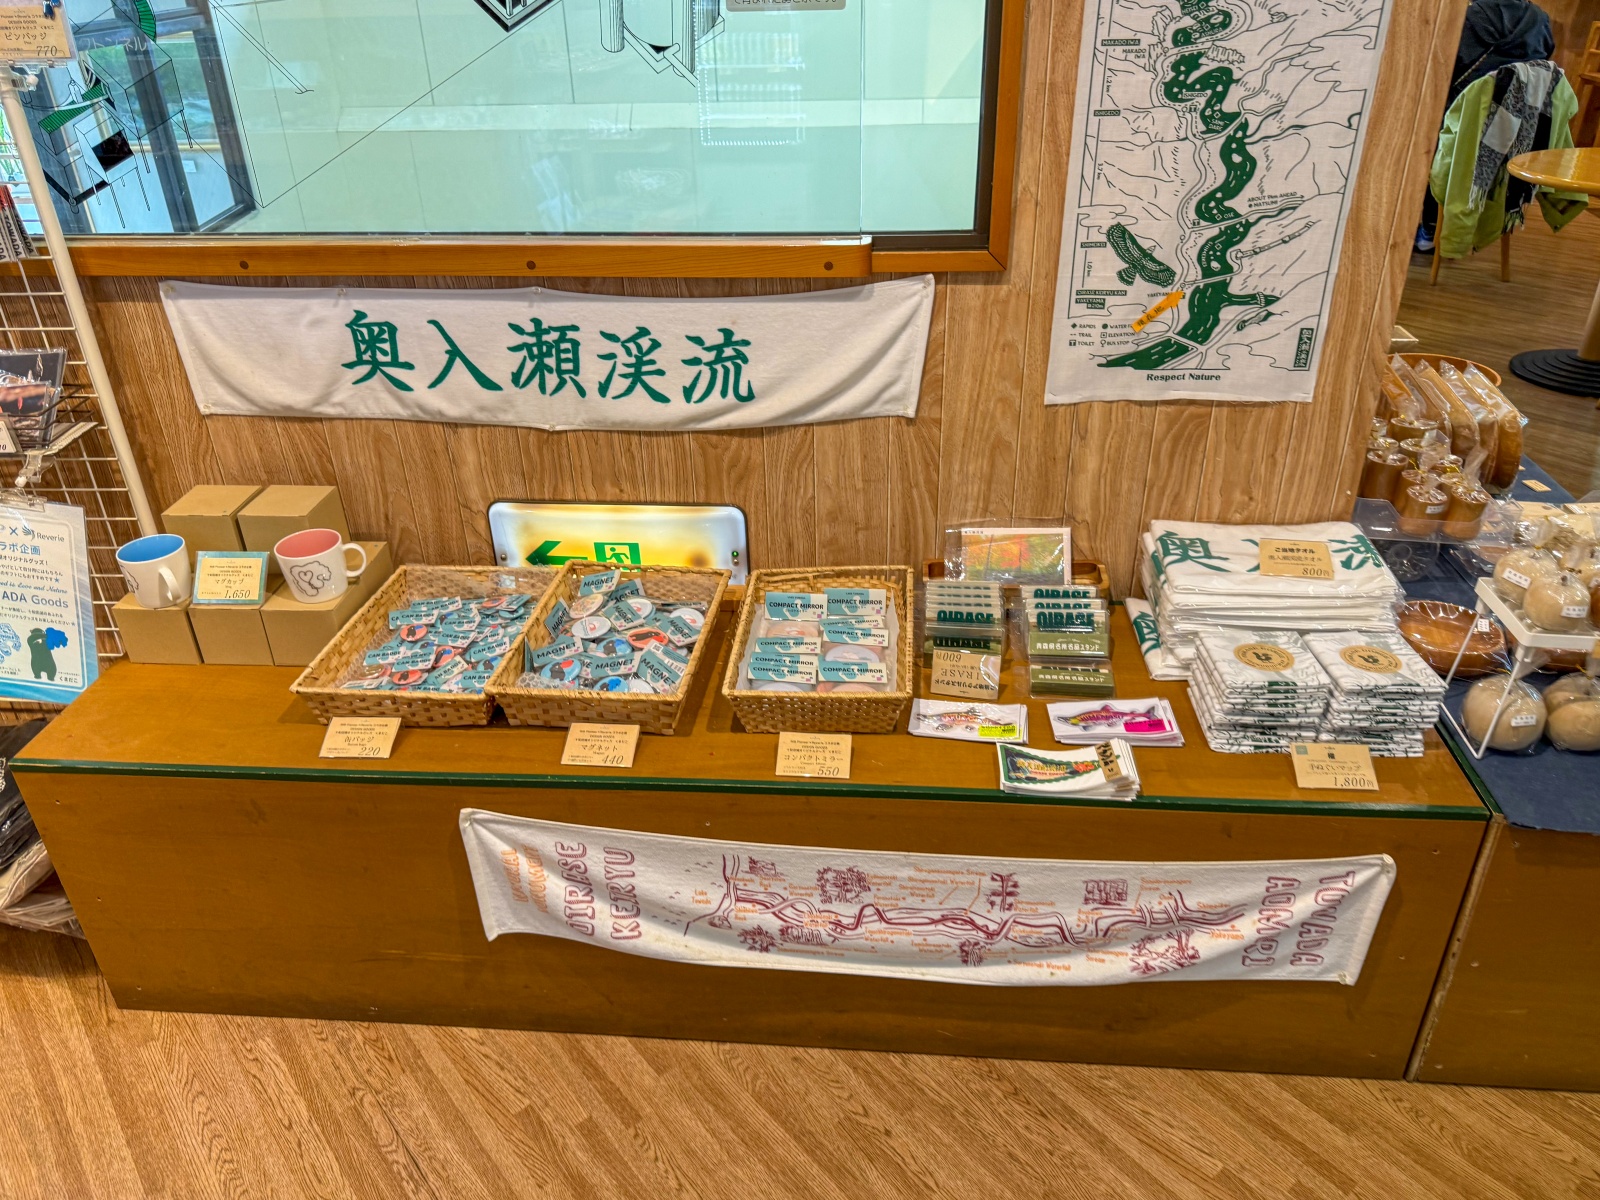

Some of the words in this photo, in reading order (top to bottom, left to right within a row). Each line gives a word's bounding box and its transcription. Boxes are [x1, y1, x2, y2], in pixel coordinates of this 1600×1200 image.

[5, 32, 46, 40] ピンバッジ
[37, 46, 57, 56] 770
[341, 309, 757, 404] 奥入瀬渓流
[1146, 373, 1185, 382] Respect
[1188, 372, 1221, 381] Nature
[36, 532, 65, 543] Reverie
[1302, 567, 1330, 577] 800円
[583, 576, 615, 587] MAGNET
[2, 590, 27, 603] ADA
[31, 594, 69, 608] Goods
[224, 589, 251, 599] 1,650
[613, 604, 634, 624] MAGNET
[1037, 611, 1095, 628] OIRASE
[668, 619, 692, 639] MAGNET
[487, 641, 507, 650] BADGE
[537, 641, 576, 659] MAGNET
[595, 658, 634, 670] MAGNET
[641, 658, 676, 686] MAGNET
[752, 666, 785, 674] COMPACT
[360, 747, 381, 756] 220
[581, 744, 618, 752] マグネット
[602, 755, 624, 764] 440
[817, 766, 840, 776] 550
[555, 842, 596, 936] OIRASE
[603, 847, 642, 940] KEIRYU
